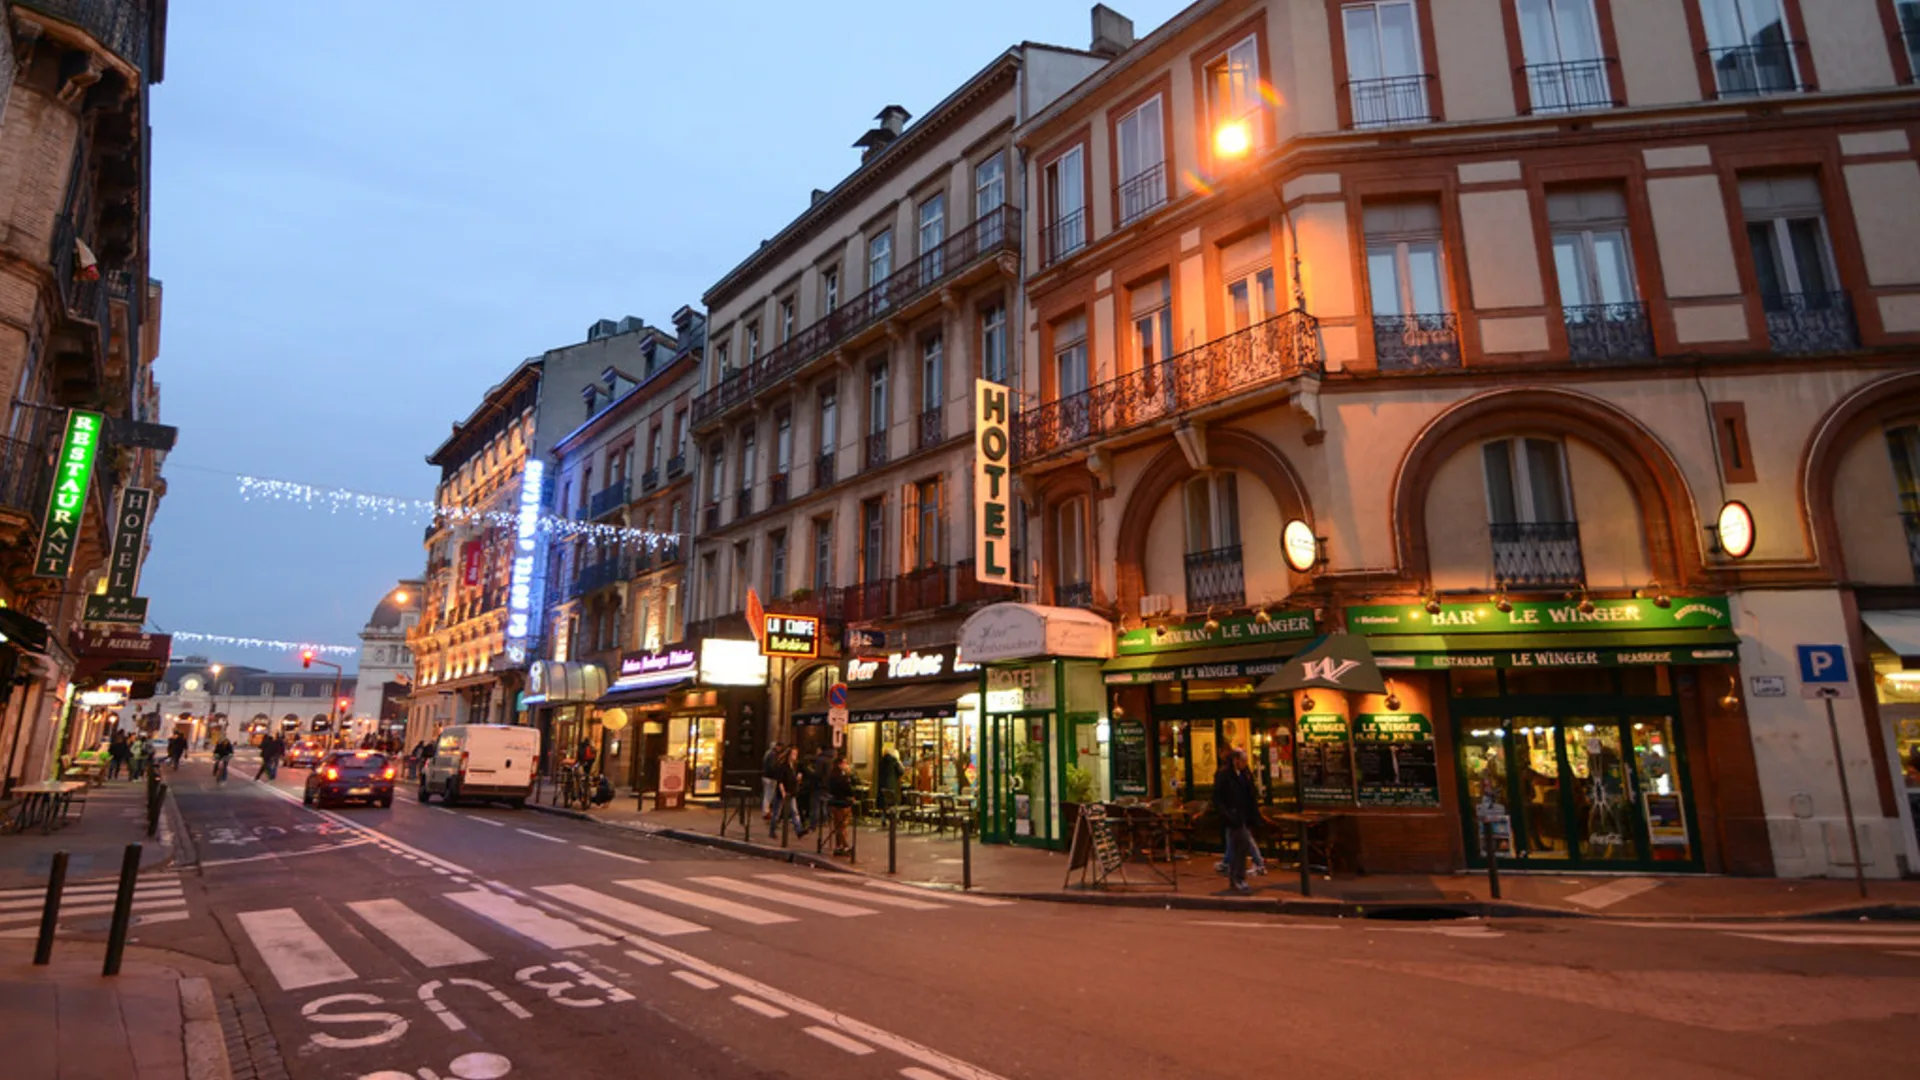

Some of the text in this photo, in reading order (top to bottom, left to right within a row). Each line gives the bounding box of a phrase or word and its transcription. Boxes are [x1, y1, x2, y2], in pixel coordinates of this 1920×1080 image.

[982, 387, 1006, 576] HOTEL
[44, 415, 94, 574] RESTAURANT
[114, 494, 145, 588] HOTEL
[511, 556, 534, 610] HOTEL
[1222, 625, 1242, 638] LE
[1247, 616, 1311, 636] WINGER
[1431, 609, 1476, 625] BAR
[1509, 608, 1539, 623] LE
[1547, 606, 1643, 622] WINGER
[847, 659, 878, 681] Bar
[888, 651, 943, 679] Tabac
[1432, 651, 1672, 666] RESTAURANT LE WINGER BRASSERIE
[1810, 651, 1833, 677] P
[987, 668, 1039, 690] HOTEL
[1181, 668, 1196, 679] LE
[1198, 665, 1239, 678] WINGER
[1362, 723, 1421, 732] LE WINGER
